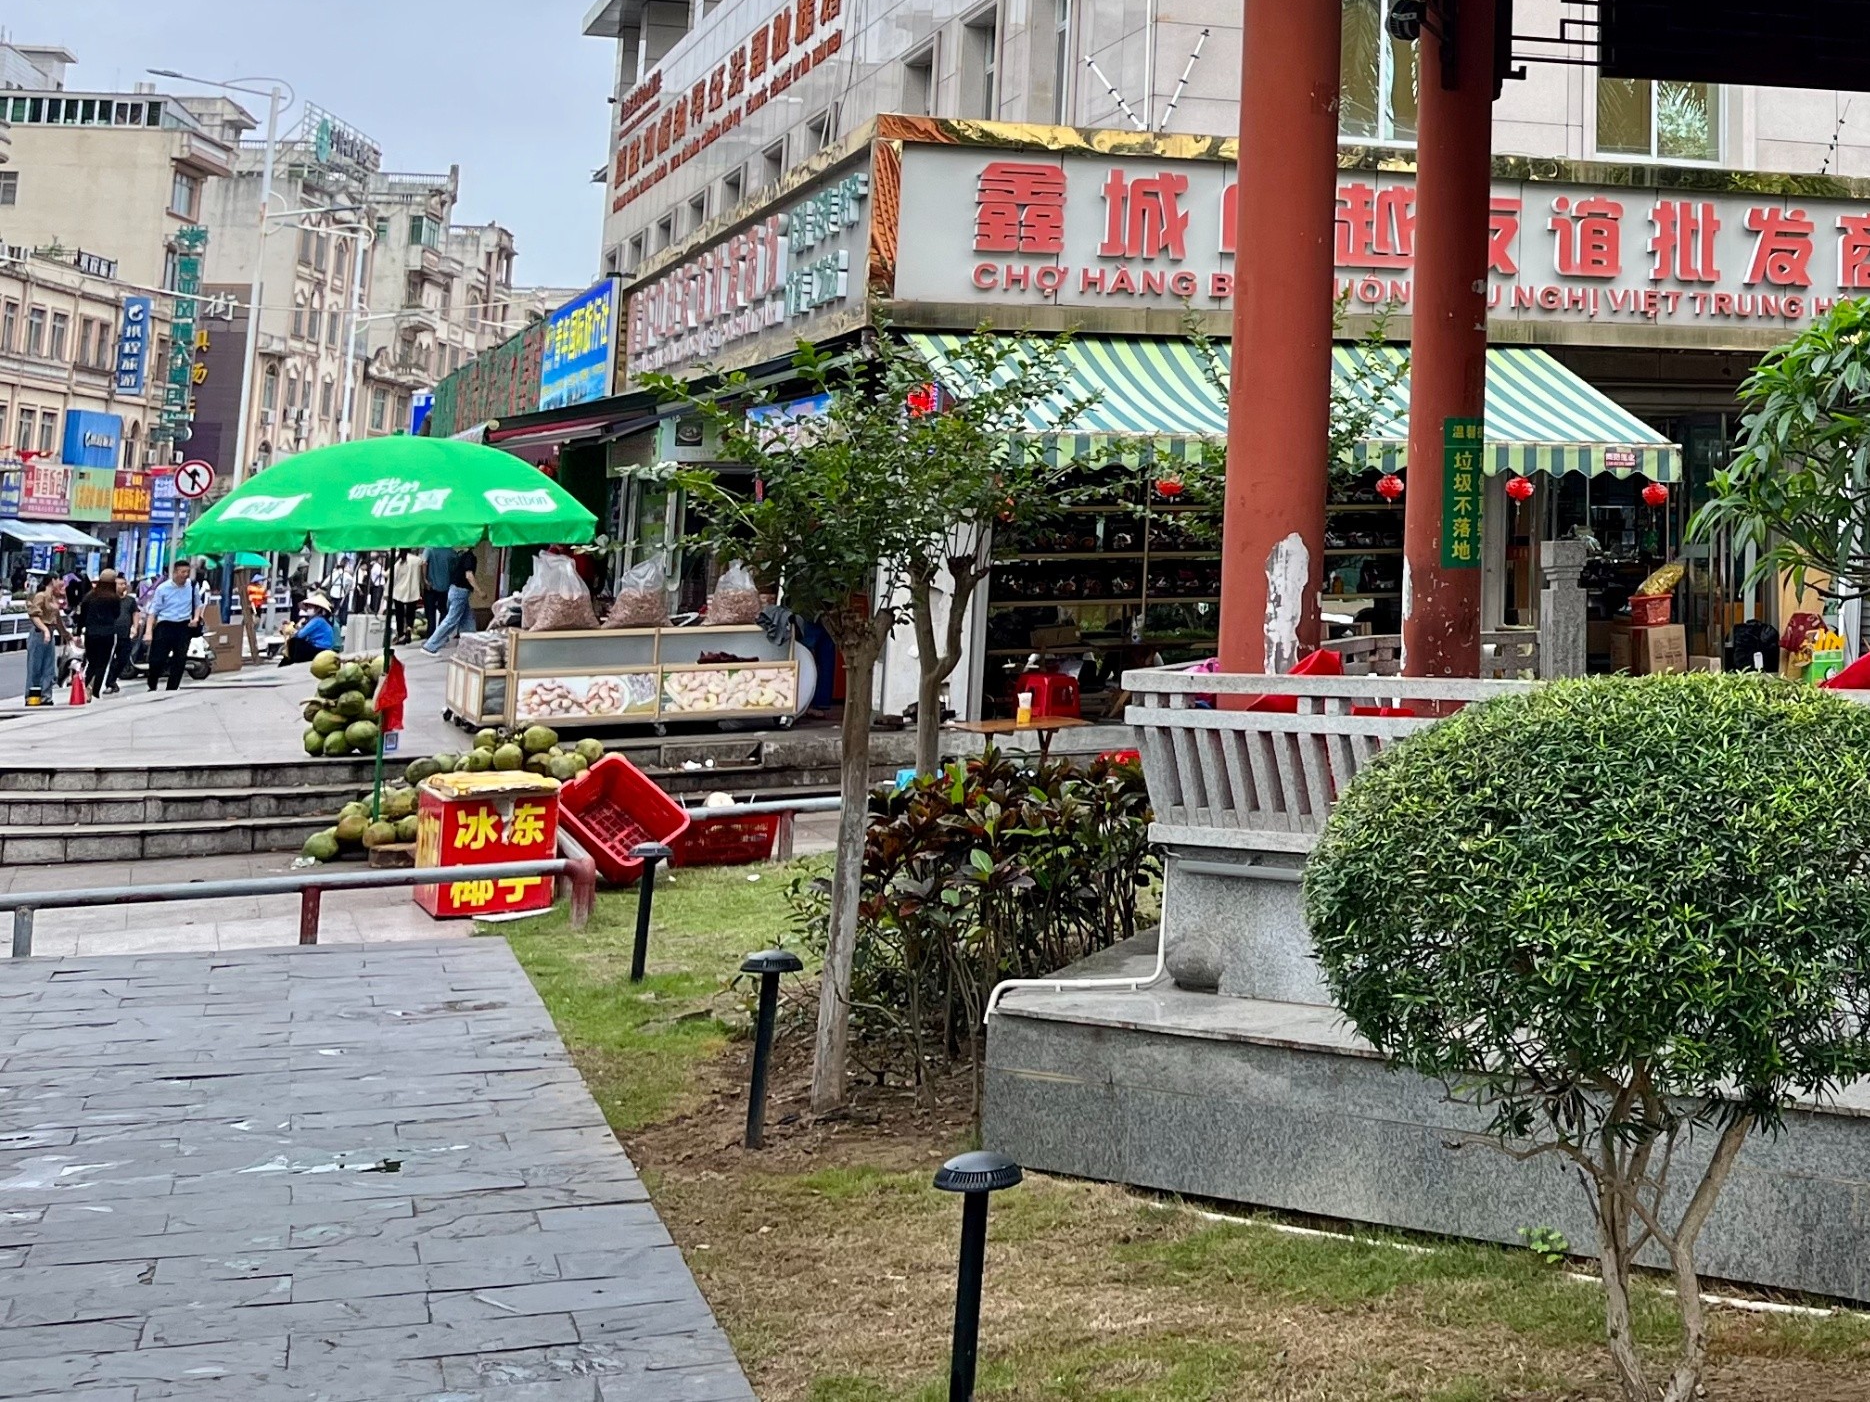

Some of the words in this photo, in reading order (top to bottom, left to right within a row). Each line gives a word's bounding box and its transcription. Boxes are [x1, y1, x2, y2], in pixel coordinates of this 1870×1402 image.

[972, 262, 1069, 297] CHỢ
[1079, 263, 1198, 296] HÀNG
[1334, 274, 1411, 305] UÔN
[1511, 285, 1599, 317] NGHỊ
[1605, 288, 1683, 318] VIỆT
[1689, 291, 1805, 319] TRUNG
[1451, 450, 1474, 561] 垃圾不落地
[453, 803, 547, 850] 冰冻
